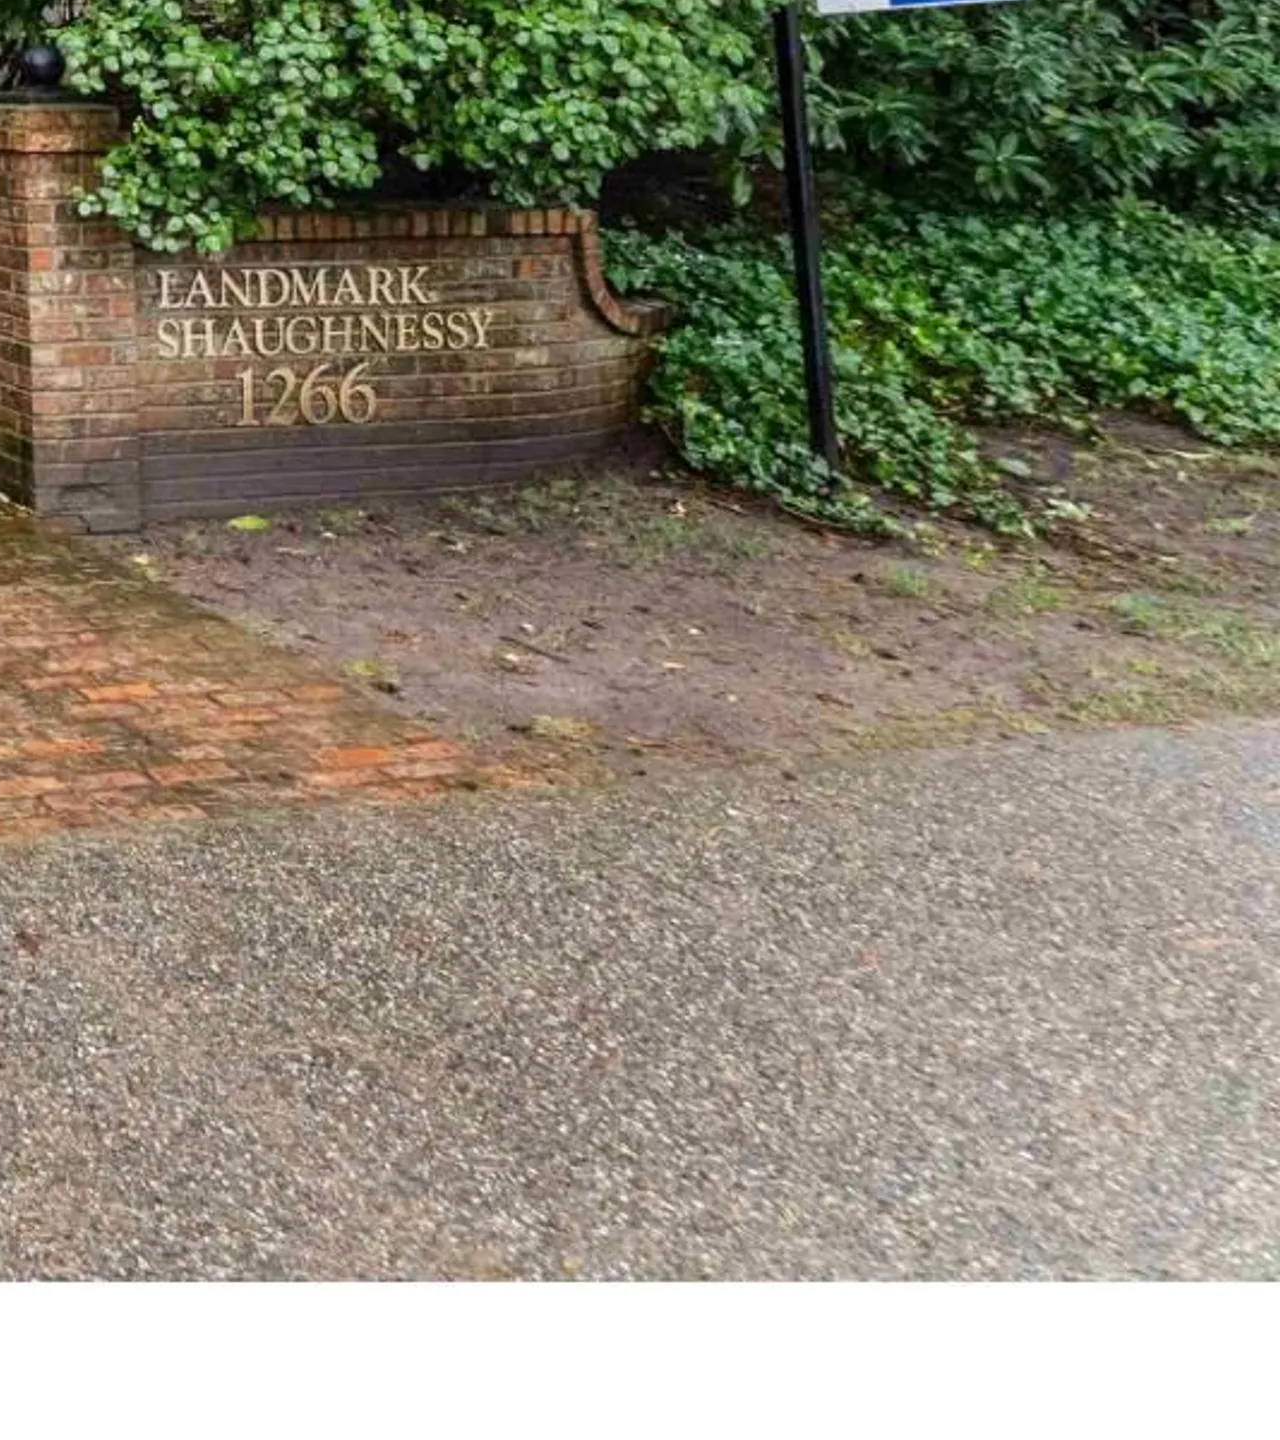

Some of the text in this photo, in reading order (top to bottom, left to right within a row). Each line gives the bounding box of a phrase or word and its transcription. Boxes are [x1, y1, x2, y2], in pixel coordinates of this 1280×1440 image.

[157, 266, 433, 308] LANDMARK
[156, 310, 494, 358] SHAUGHNESSY
[235, 362, 378, 427] 1266
